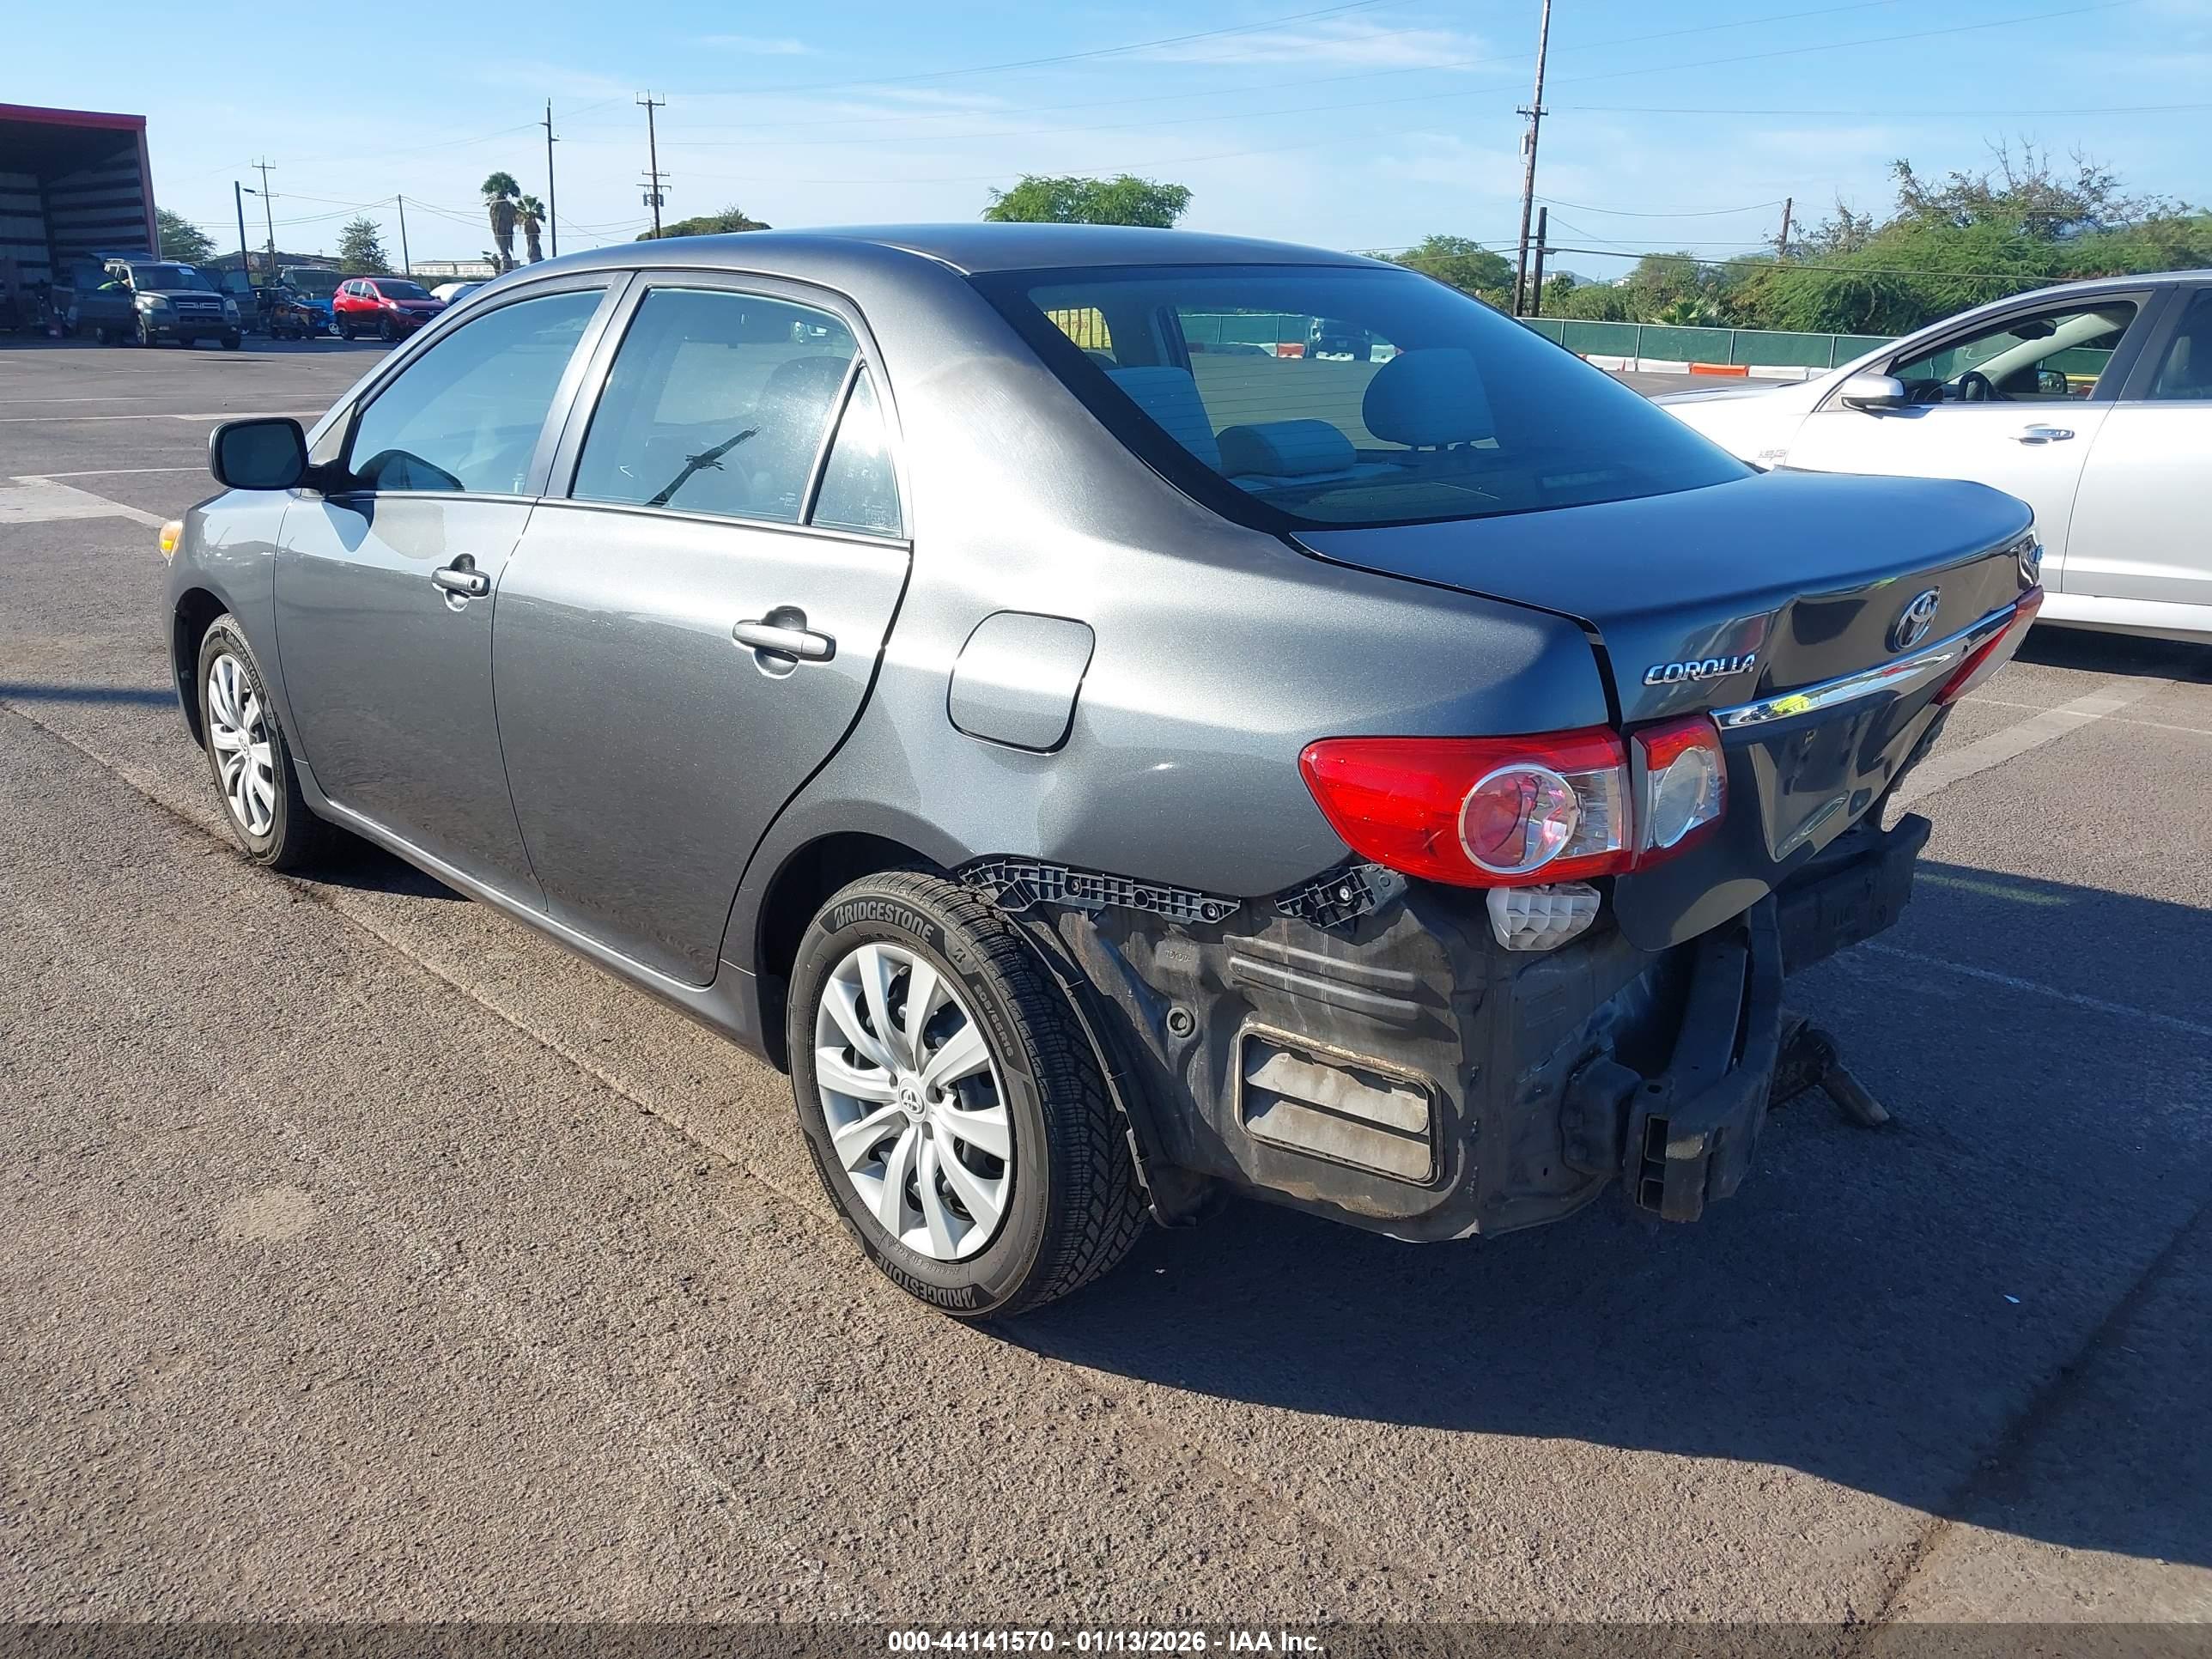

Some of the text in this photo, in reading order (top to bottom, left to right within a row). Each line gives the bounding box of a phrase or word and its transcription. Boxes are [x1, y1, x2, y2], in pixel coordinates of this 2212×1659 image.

[1644, 653, 1756, 685] COROLLA
[834, 901, 934, 943] BRIDGESTONE
[874, 1251, 977, 1309] BRIDGESTONE
